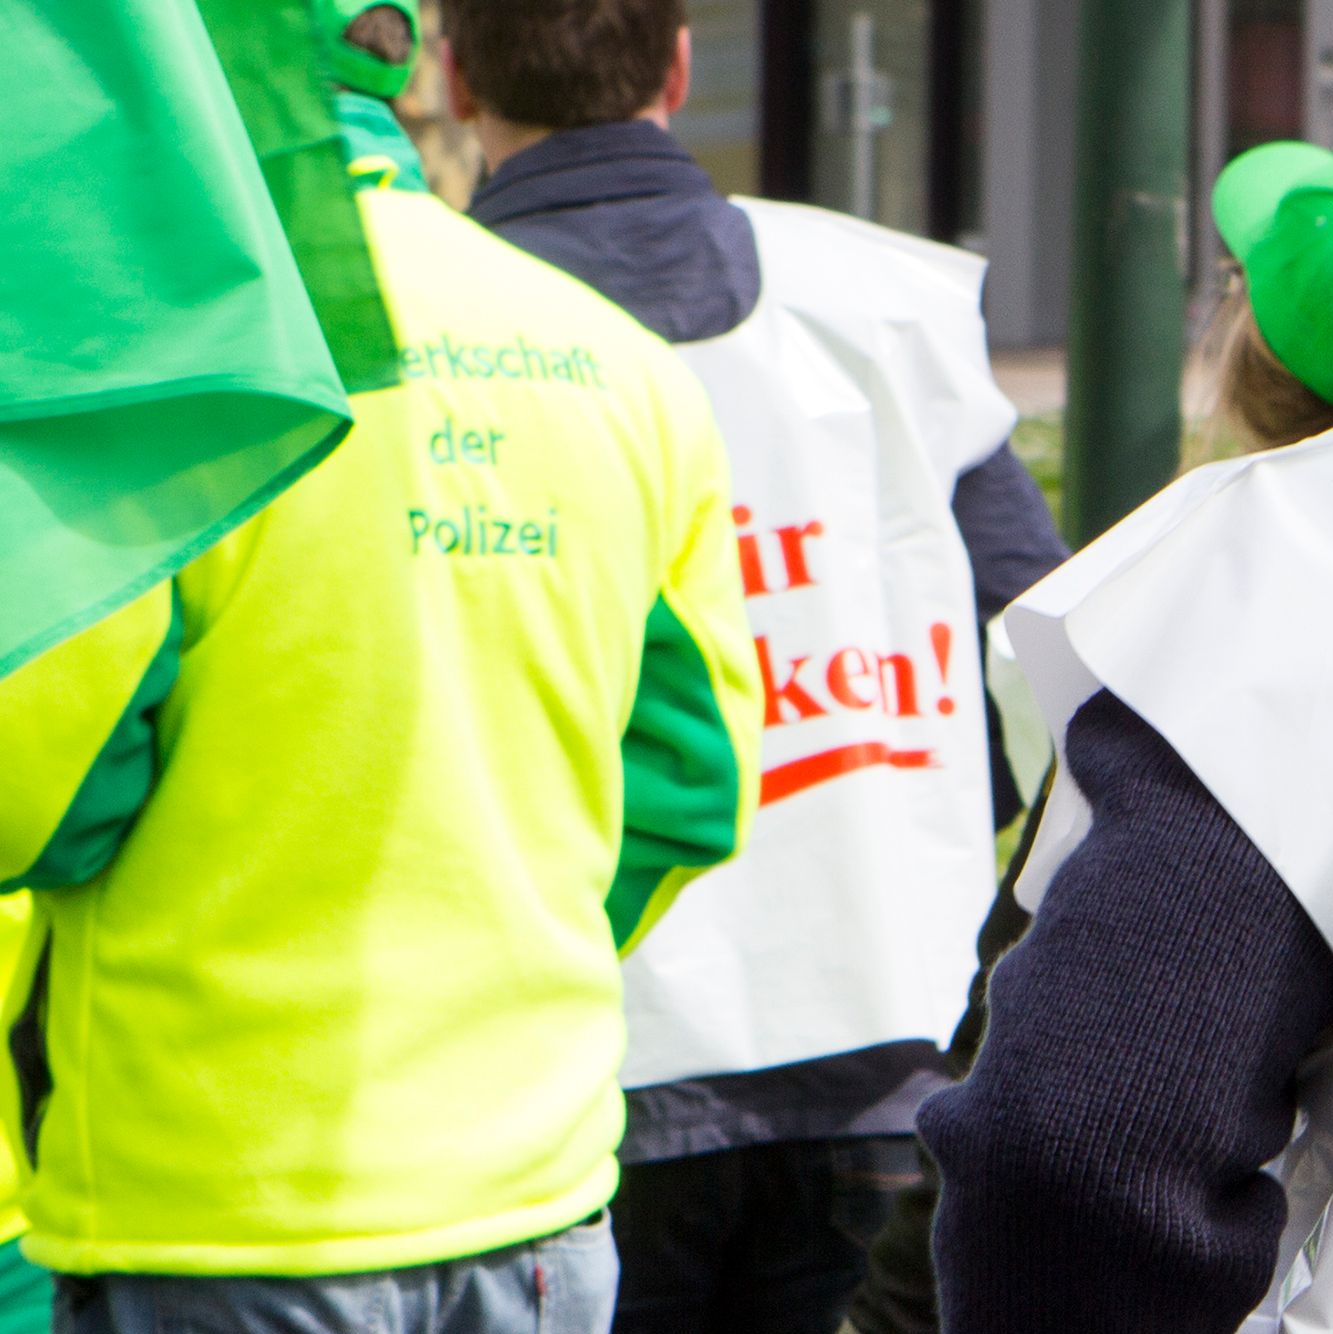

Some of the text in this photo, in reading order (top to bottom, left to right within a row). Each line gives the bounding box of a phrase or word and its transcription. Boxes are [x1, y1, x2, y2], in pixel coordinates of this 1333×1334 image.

[402, 334, 606, 389] erkschaft
[430, 415, 506, 465] der
[408, 505, 557, 557] Polizei
[732, 505, 823, 598] ir
[754, 622, 956, 729] ken!
